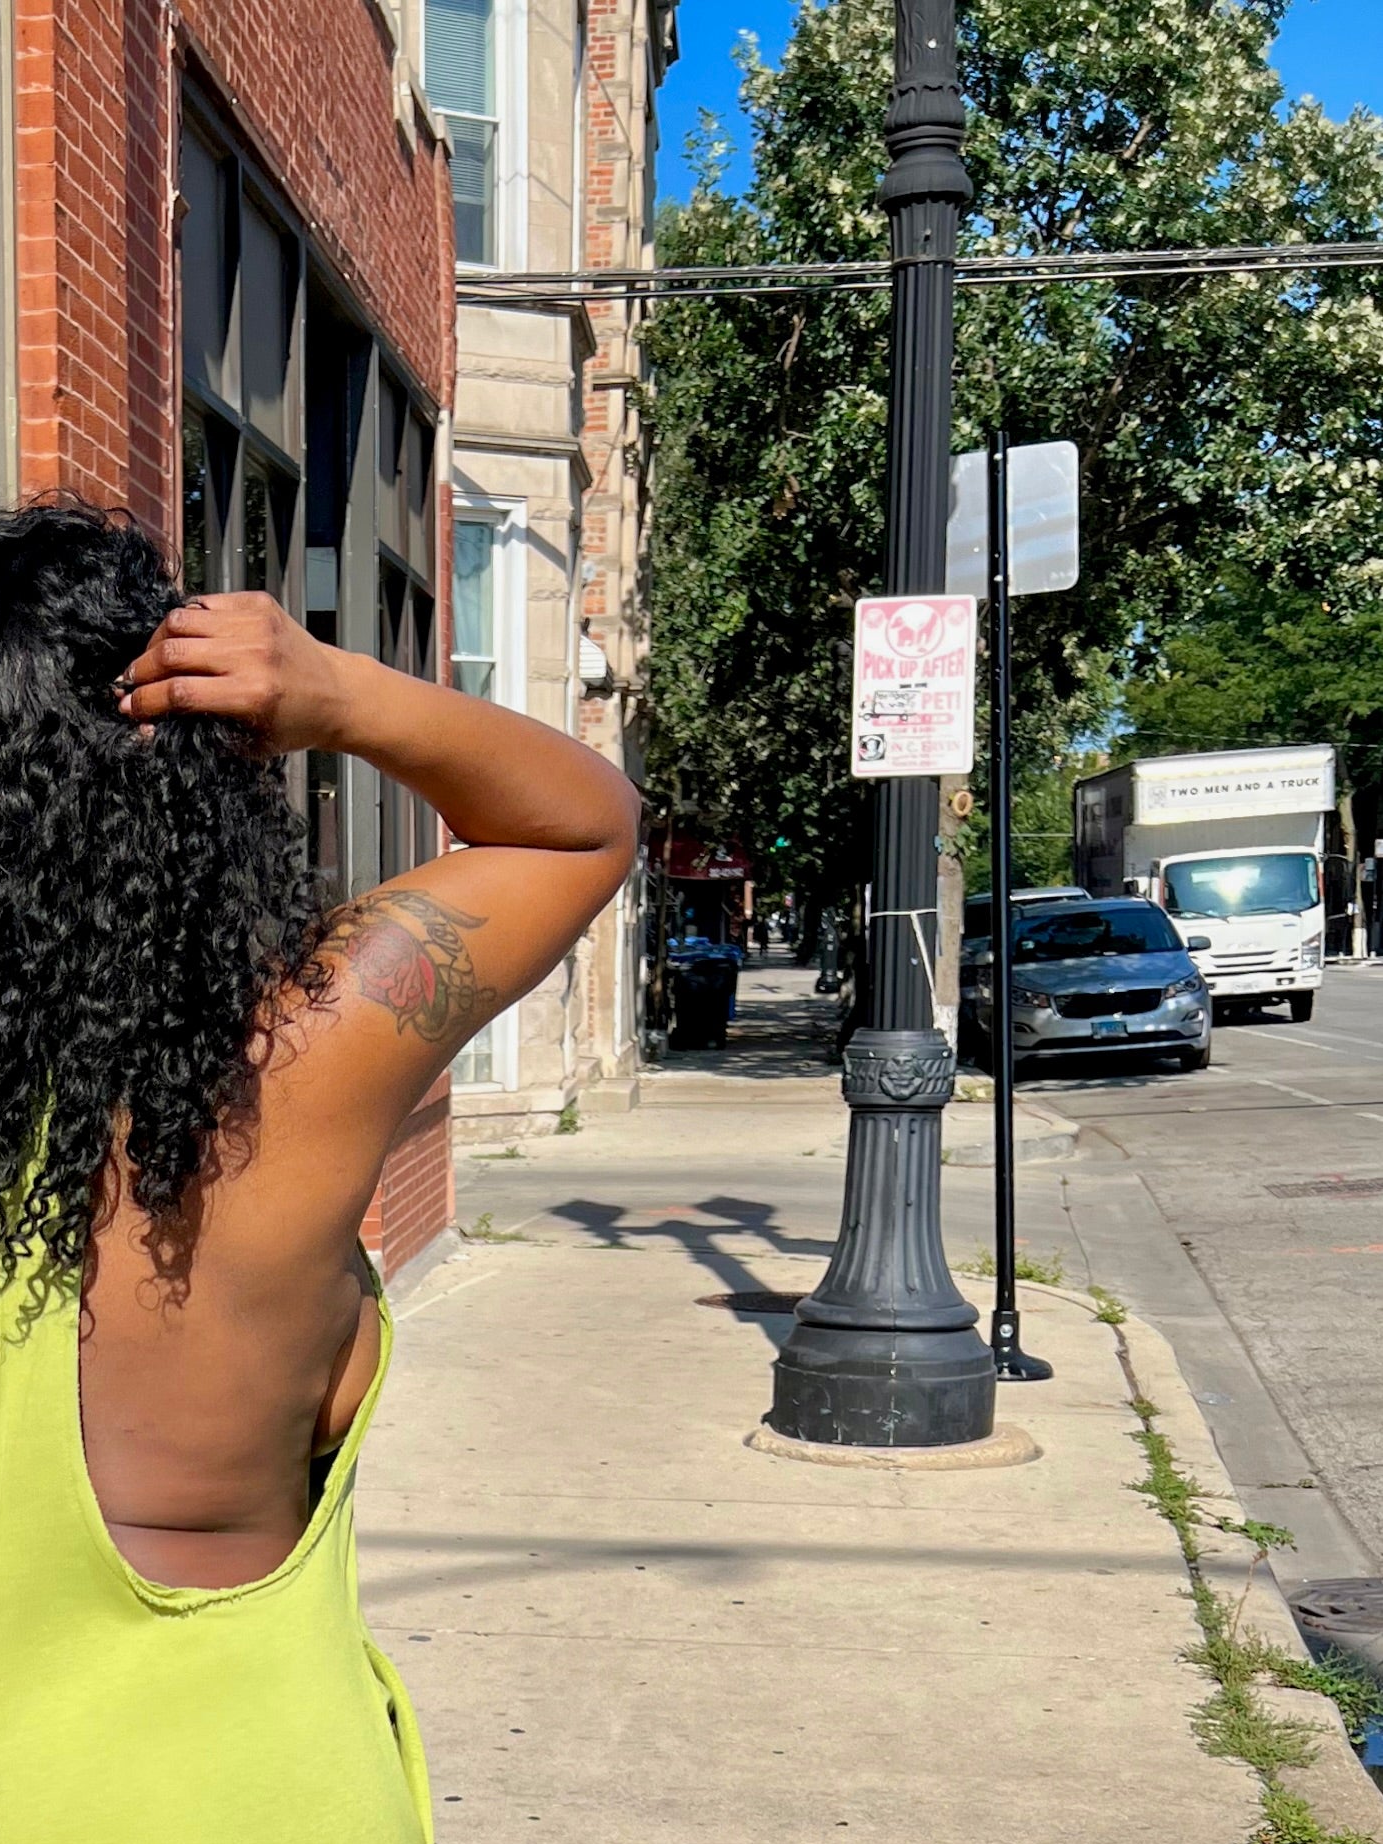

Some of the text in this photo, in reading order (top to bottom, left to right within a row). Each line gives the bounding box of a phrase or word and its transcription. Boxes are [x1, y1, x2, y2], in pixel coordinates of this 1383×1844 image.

[863, 647, 964, 680] PICK UP AFTER
[1170, 777, 1320, 797] TWO MEN AND A TRUCK
